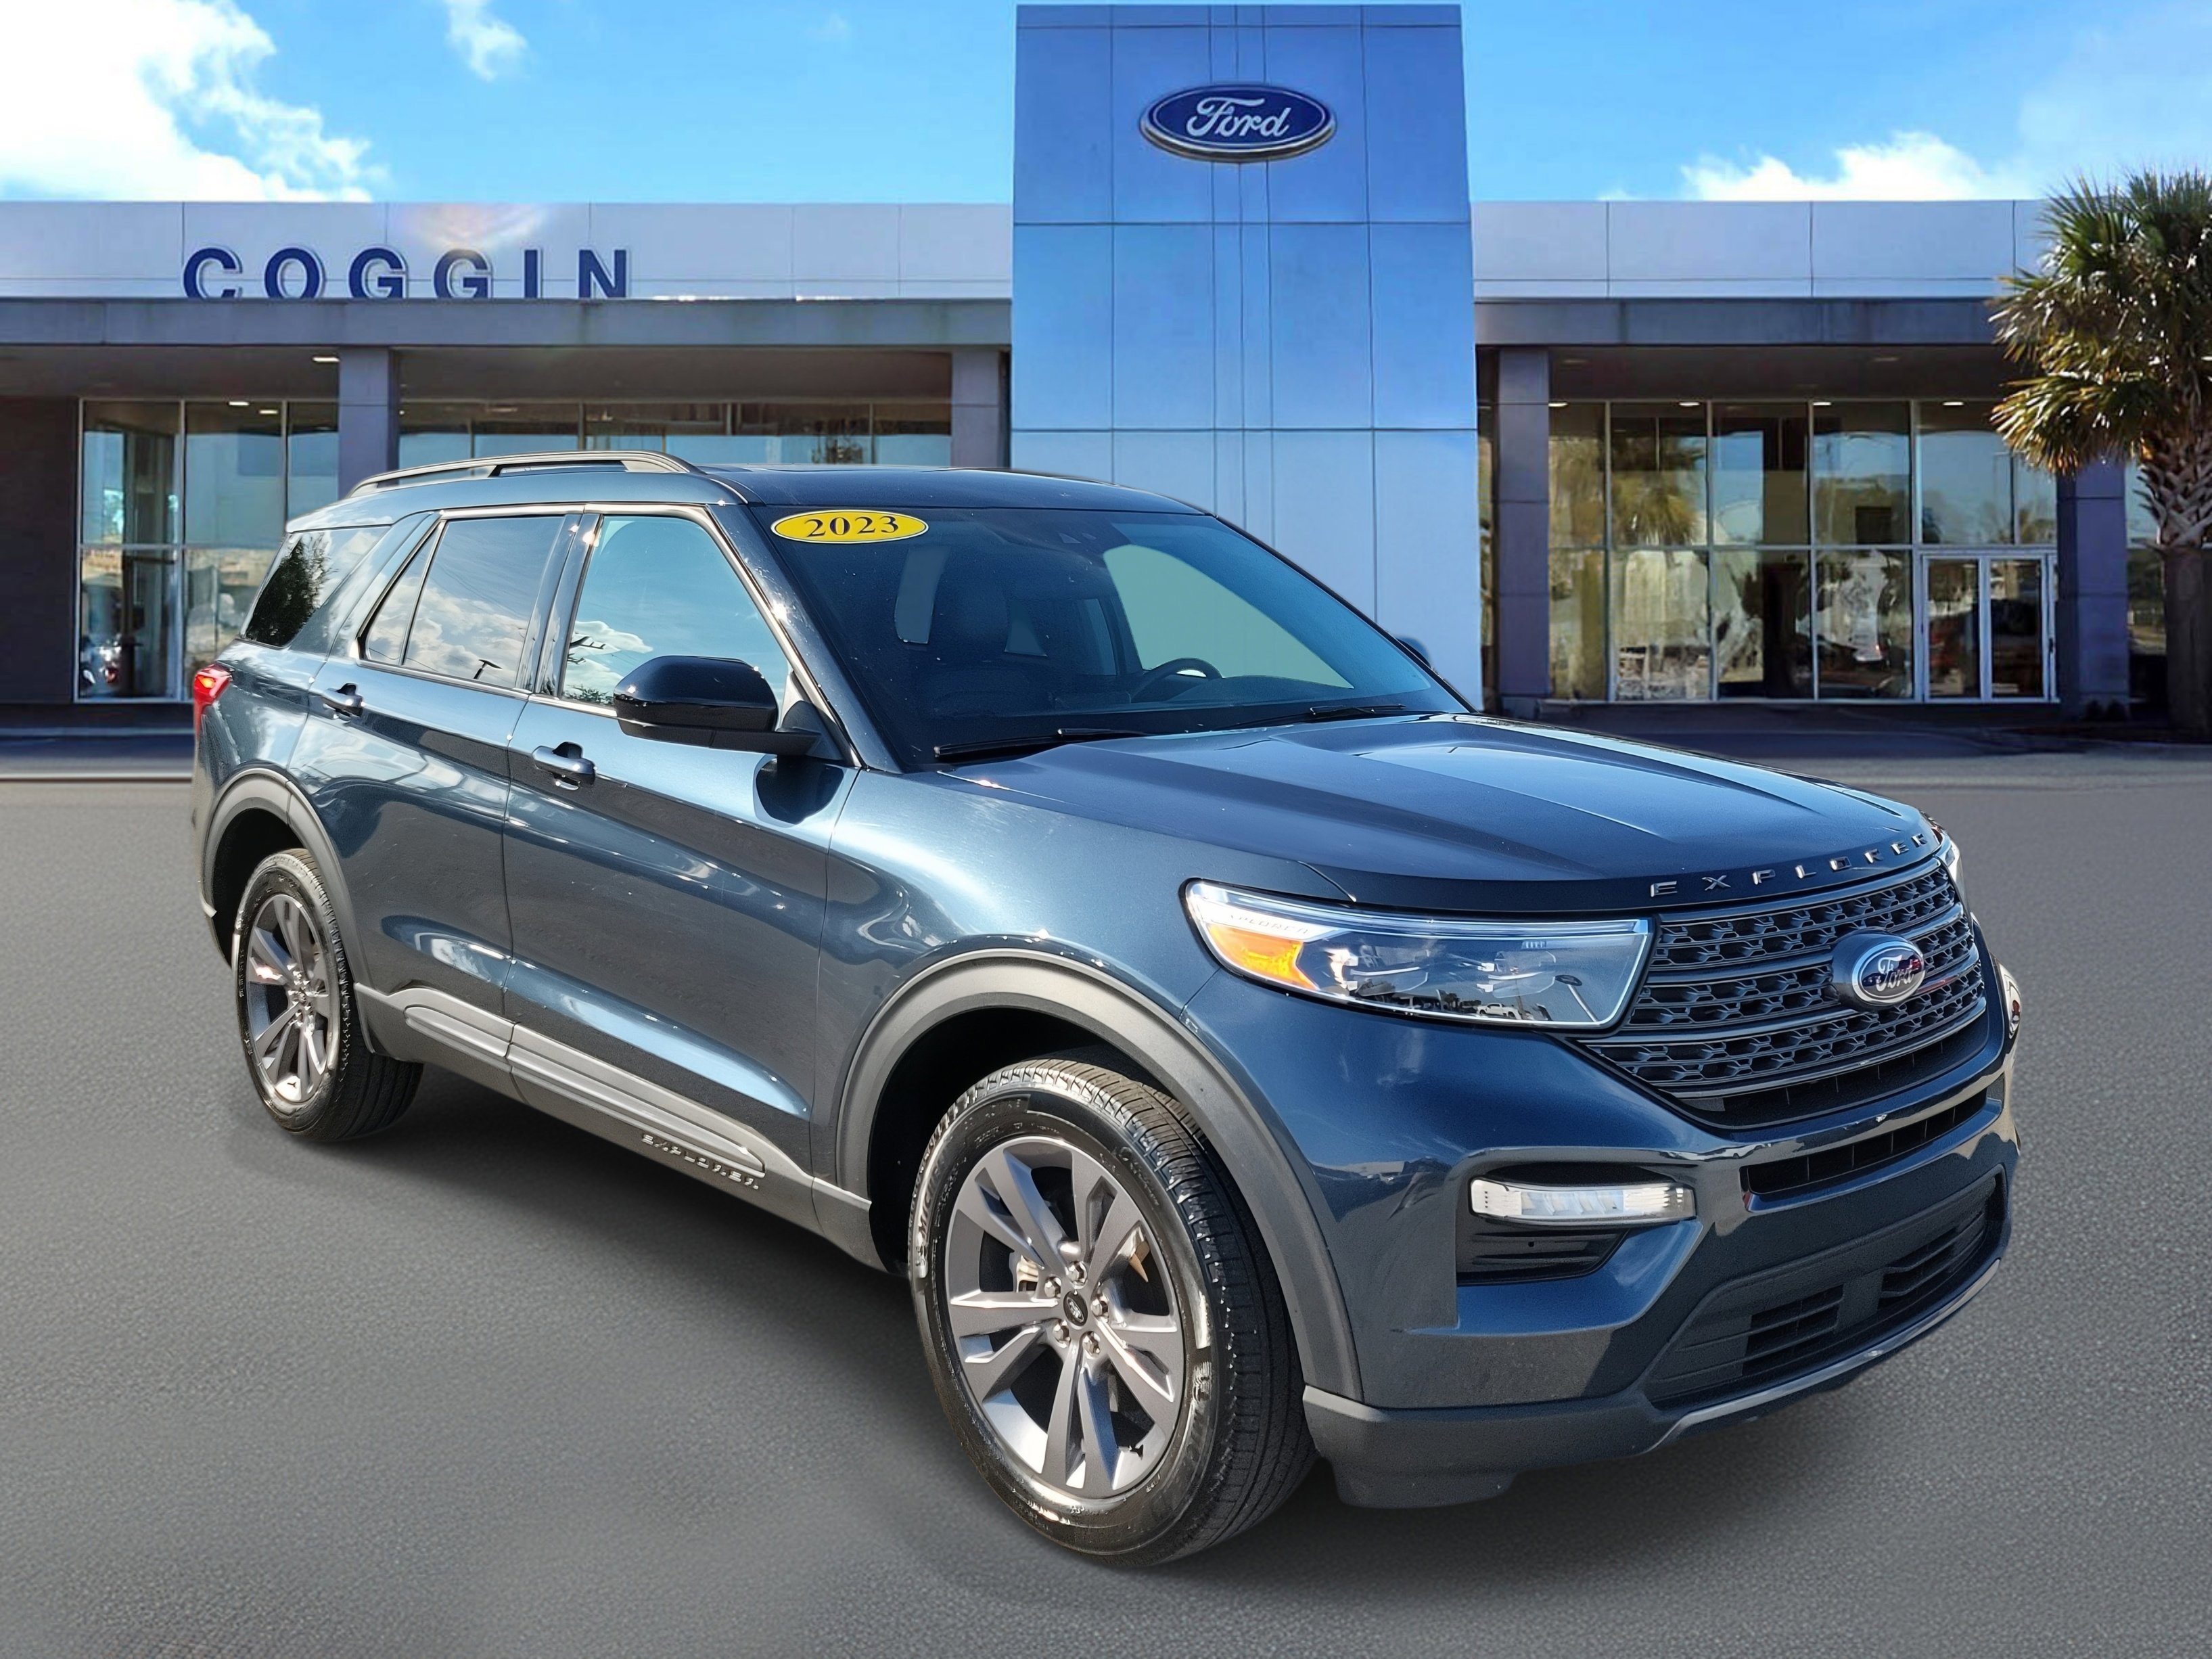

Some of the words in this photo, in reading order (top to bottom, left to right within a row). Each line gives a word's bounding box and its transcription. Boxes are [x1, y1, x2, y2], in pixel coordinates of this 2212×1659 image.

[1186, 96, 1291, 137] Ford
[183, 247, 628, 299] COGGIN
[804, 516, 898, 538] 2023
[1649, 833, 1928, 899] EXPLORER
[1876, 955, 1919, 992] Ford
